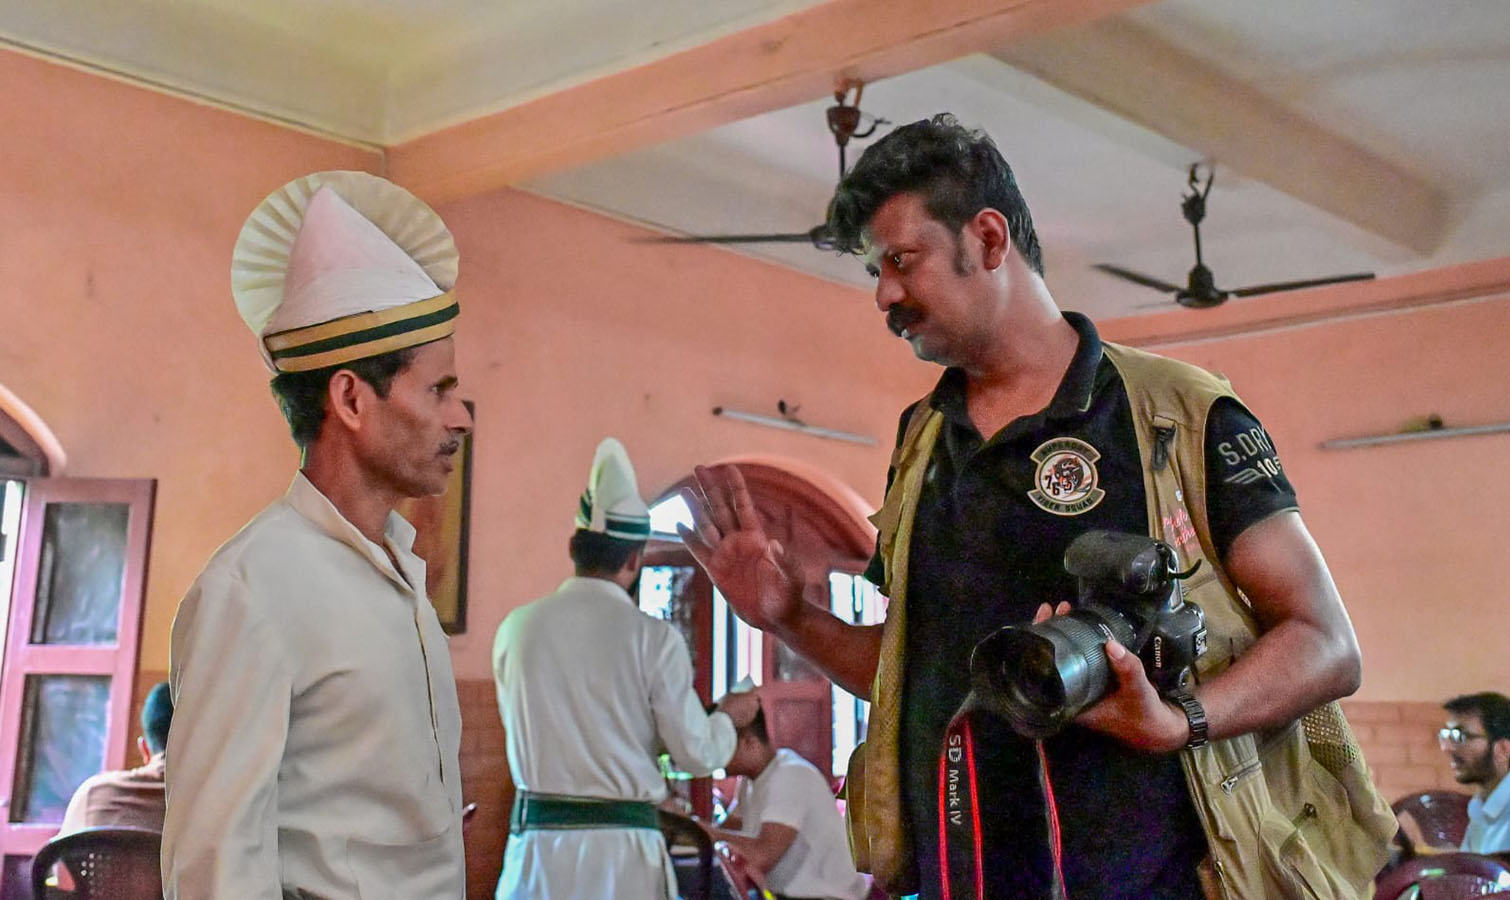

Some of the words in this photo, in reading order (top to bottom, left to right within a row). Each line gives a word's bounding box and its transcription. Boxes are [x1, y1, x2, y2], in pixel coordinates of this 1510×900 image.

[1218, 426, 1272, 465] S.DRY
[1154, 636, 1162, 668] Canon
[949, 769, 961, 806] Mark
[949, 811, 962, 826] IV
